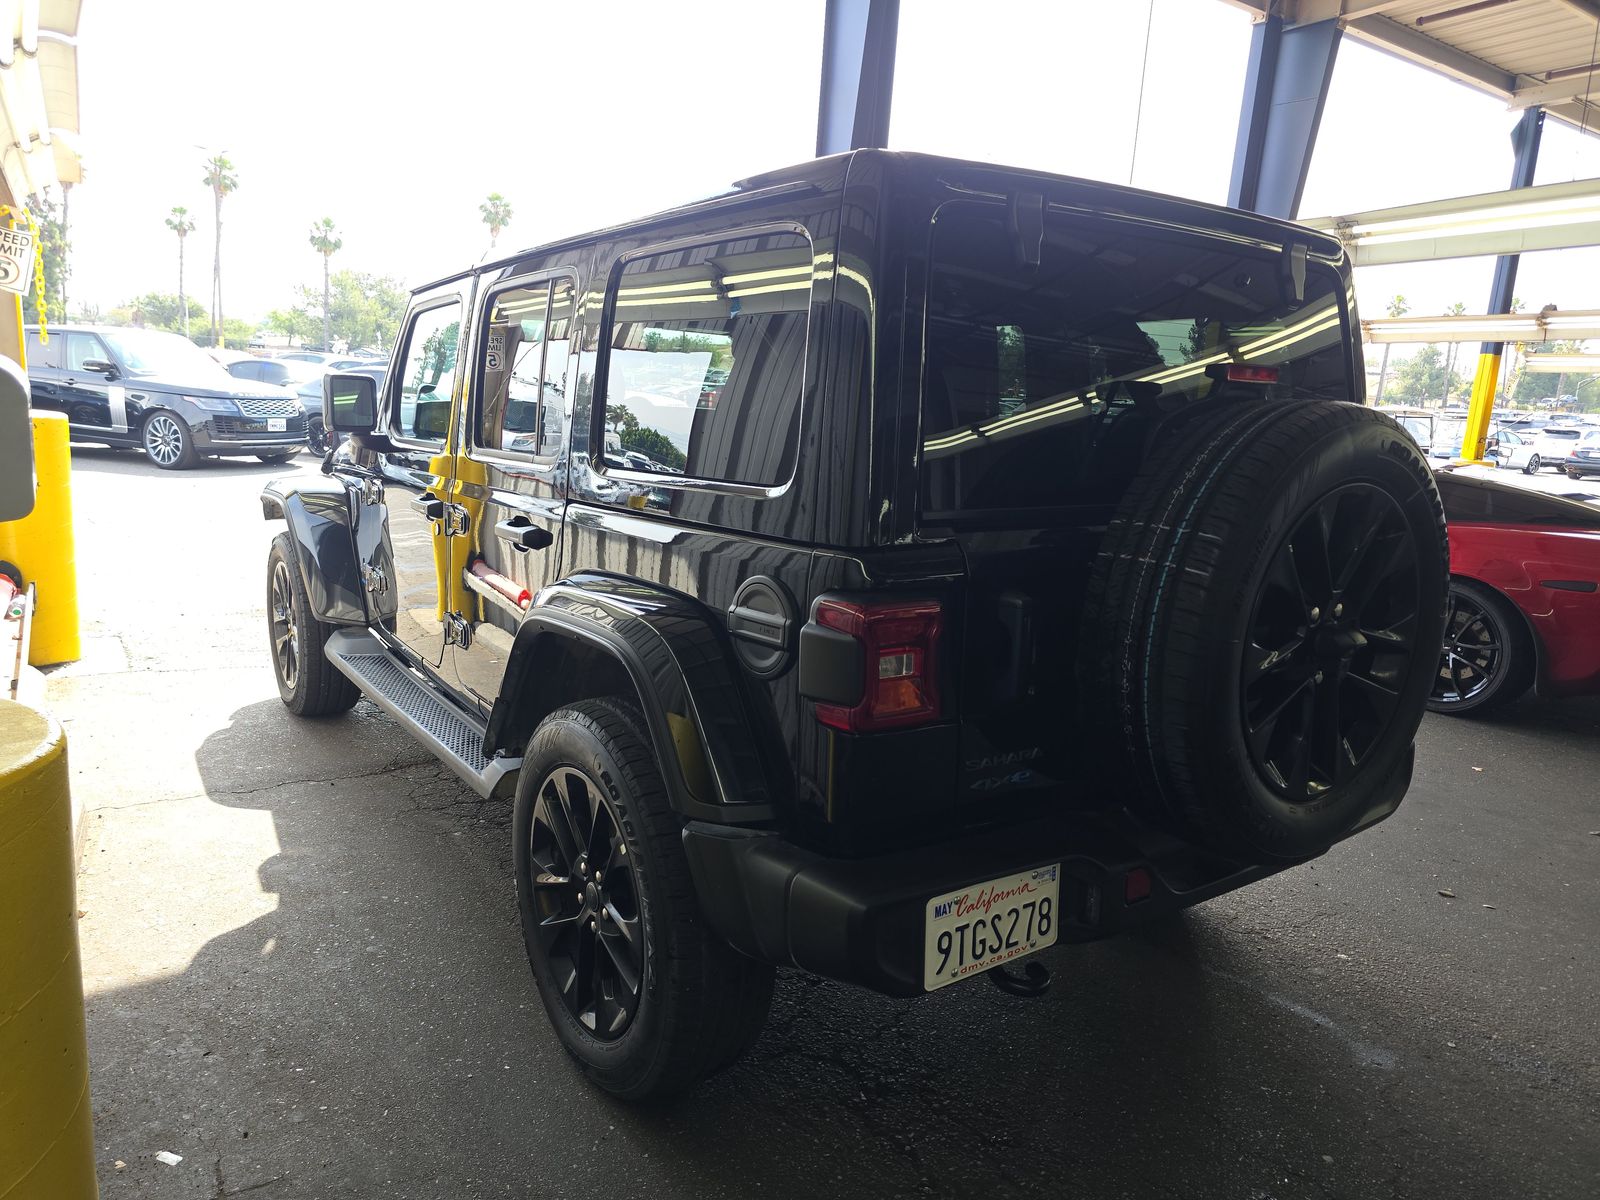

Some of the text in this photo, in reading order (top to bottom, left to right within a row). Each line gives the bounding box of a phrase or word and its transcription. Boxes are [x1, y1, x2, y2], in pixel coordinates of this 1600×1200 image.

[0, 230, 30, 246] EED
[0, 259, 11, 280] 5
[966, 747, 1041, 771] SAHARA
[934, 901, 953, 919] MAY
[956, 880, 1038, 918] California
[935, 896, 1052, 976] 9TGS278
[959, 945, 1028, 974] dmv.ca.gov
